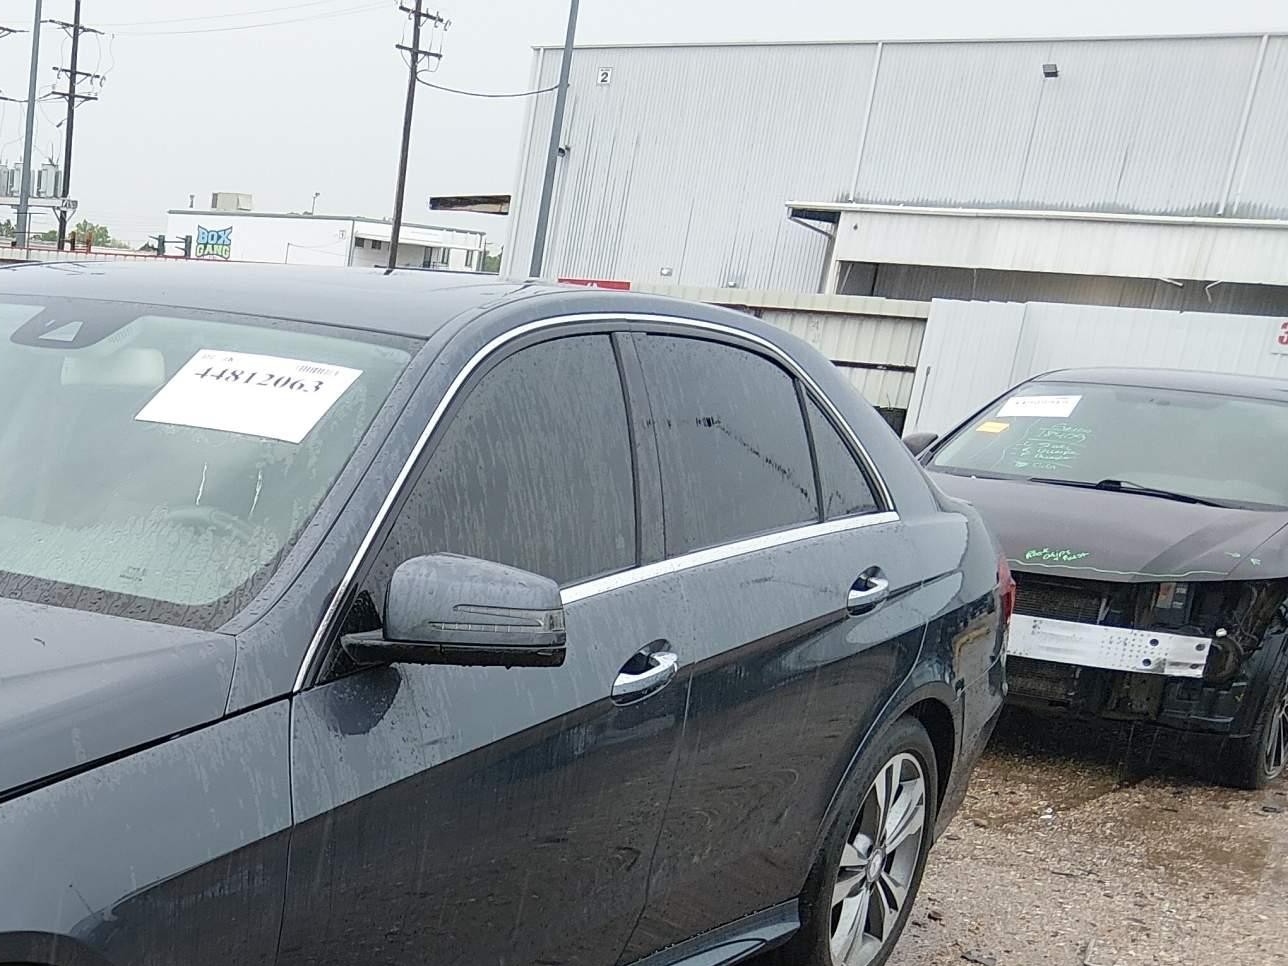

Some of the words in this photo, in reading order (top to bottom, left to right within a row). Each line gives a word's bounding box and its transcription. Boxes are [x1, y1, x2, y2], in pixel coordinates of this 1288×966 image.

[601, 71, 609, 83] 2
[198, 225, 232, 245] BOX
[196, 244, 230, 259] GANG
[194, 366, 324, 393] 44812063
